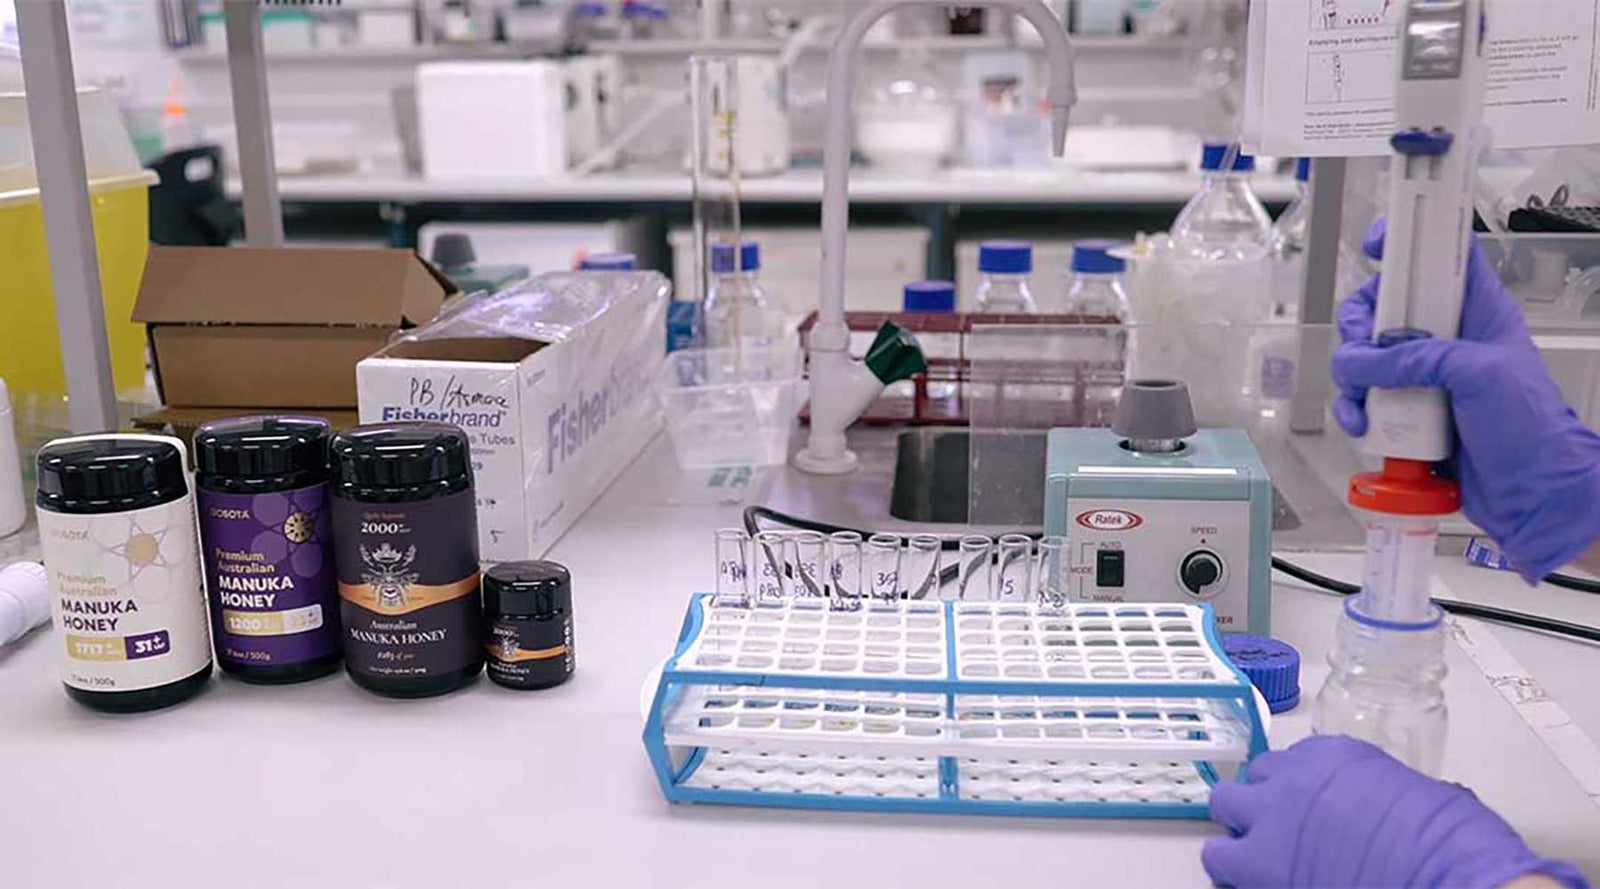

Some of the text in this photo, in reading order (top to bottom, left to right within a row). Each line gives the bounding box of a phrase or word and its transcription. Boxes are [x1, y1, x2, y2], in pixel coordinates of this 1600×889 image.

[480, 433, 516, 446] Tubes
[1094, 513, 1122, 524] Ratek
[1190, 526, 1218, 534] SPEED
[215, 546, 265, 561] Premium
[218, 560, 275, 574] Australian
[1070, 565, 1093, 574] MODE
[219, 575, 294, 591] MANUKA
[61, 598, 138, 615] MANUKA
[221, 591, 275, 608] HONEY
[63, 615, 118, 632] HONEY
[370, 620, 418, 631] Australian
[350, 628, 448, 645] MANUKA HONEY
